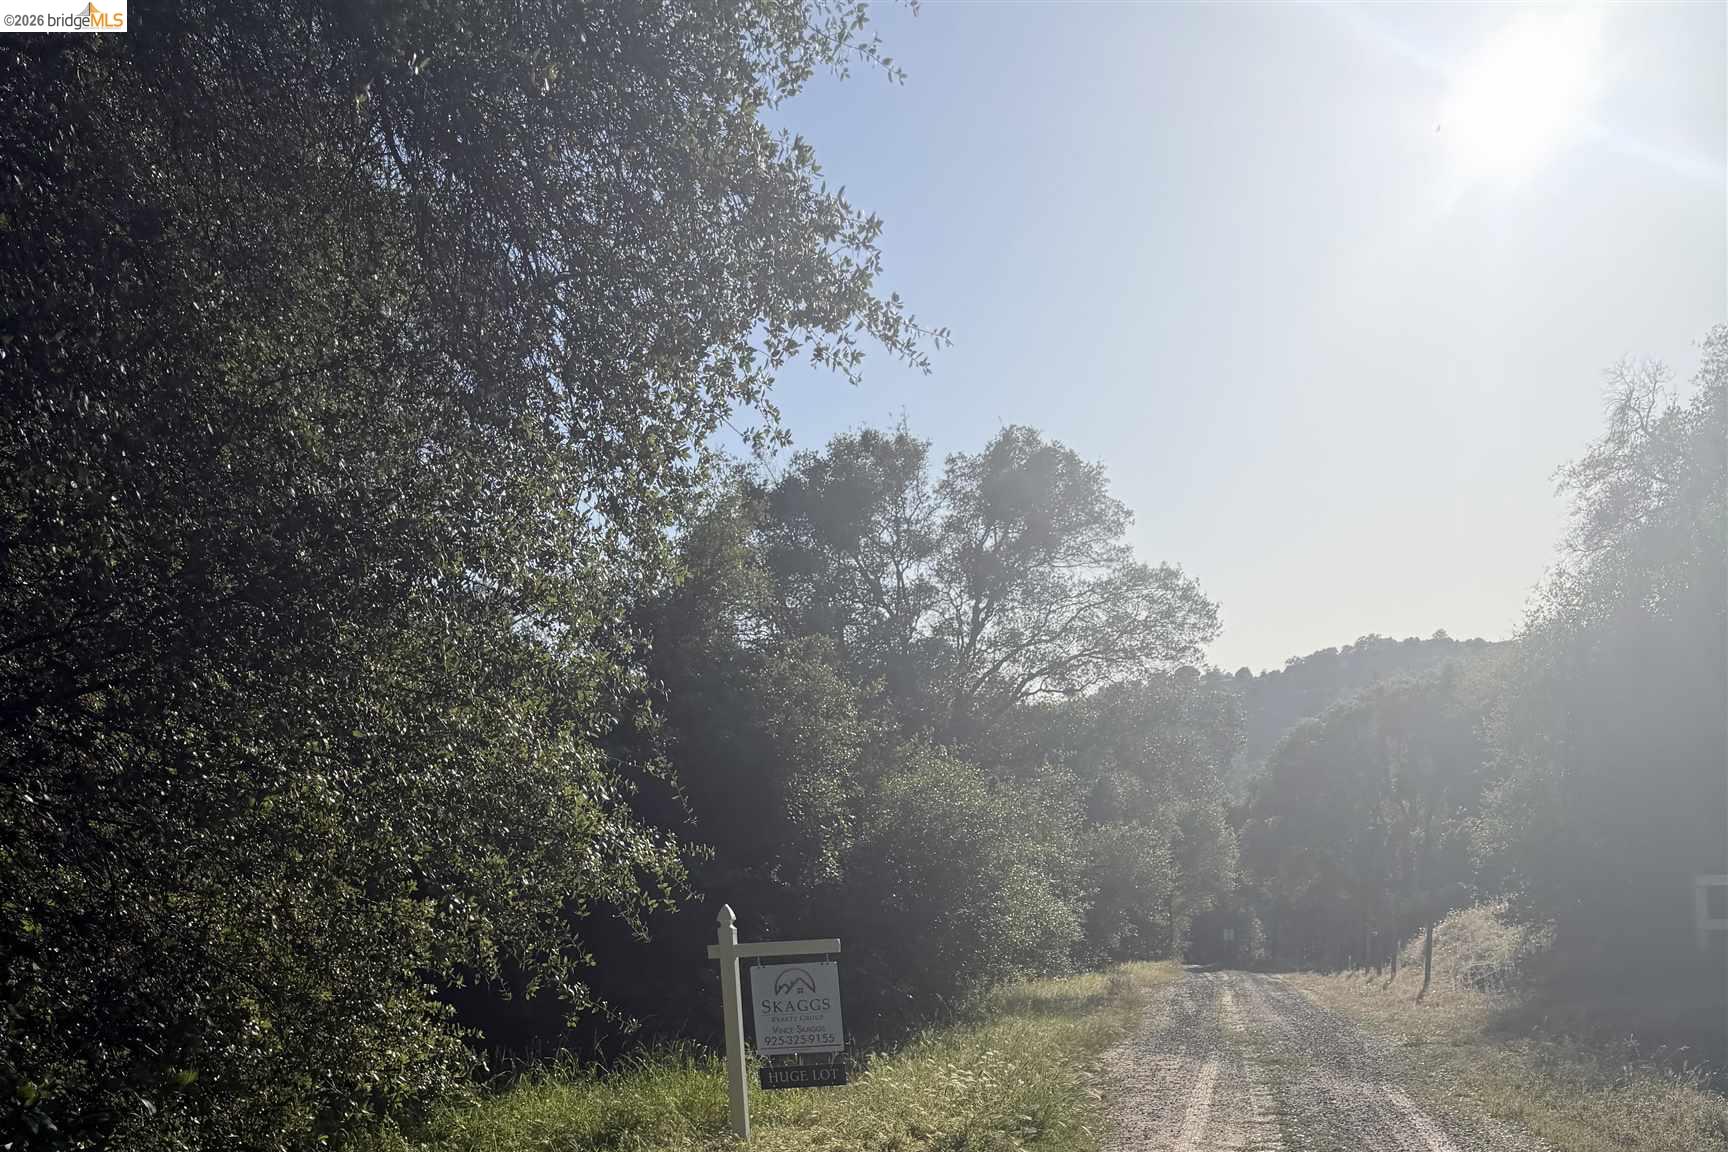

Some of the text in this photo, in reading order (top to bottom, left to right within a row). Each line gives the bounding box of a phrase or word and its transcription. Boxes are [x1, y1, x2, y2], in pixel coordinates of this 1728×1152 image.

[761, 999, 831, 1014] SKAGGS
[769, 1069, 840, 1083] HUGE LOT
